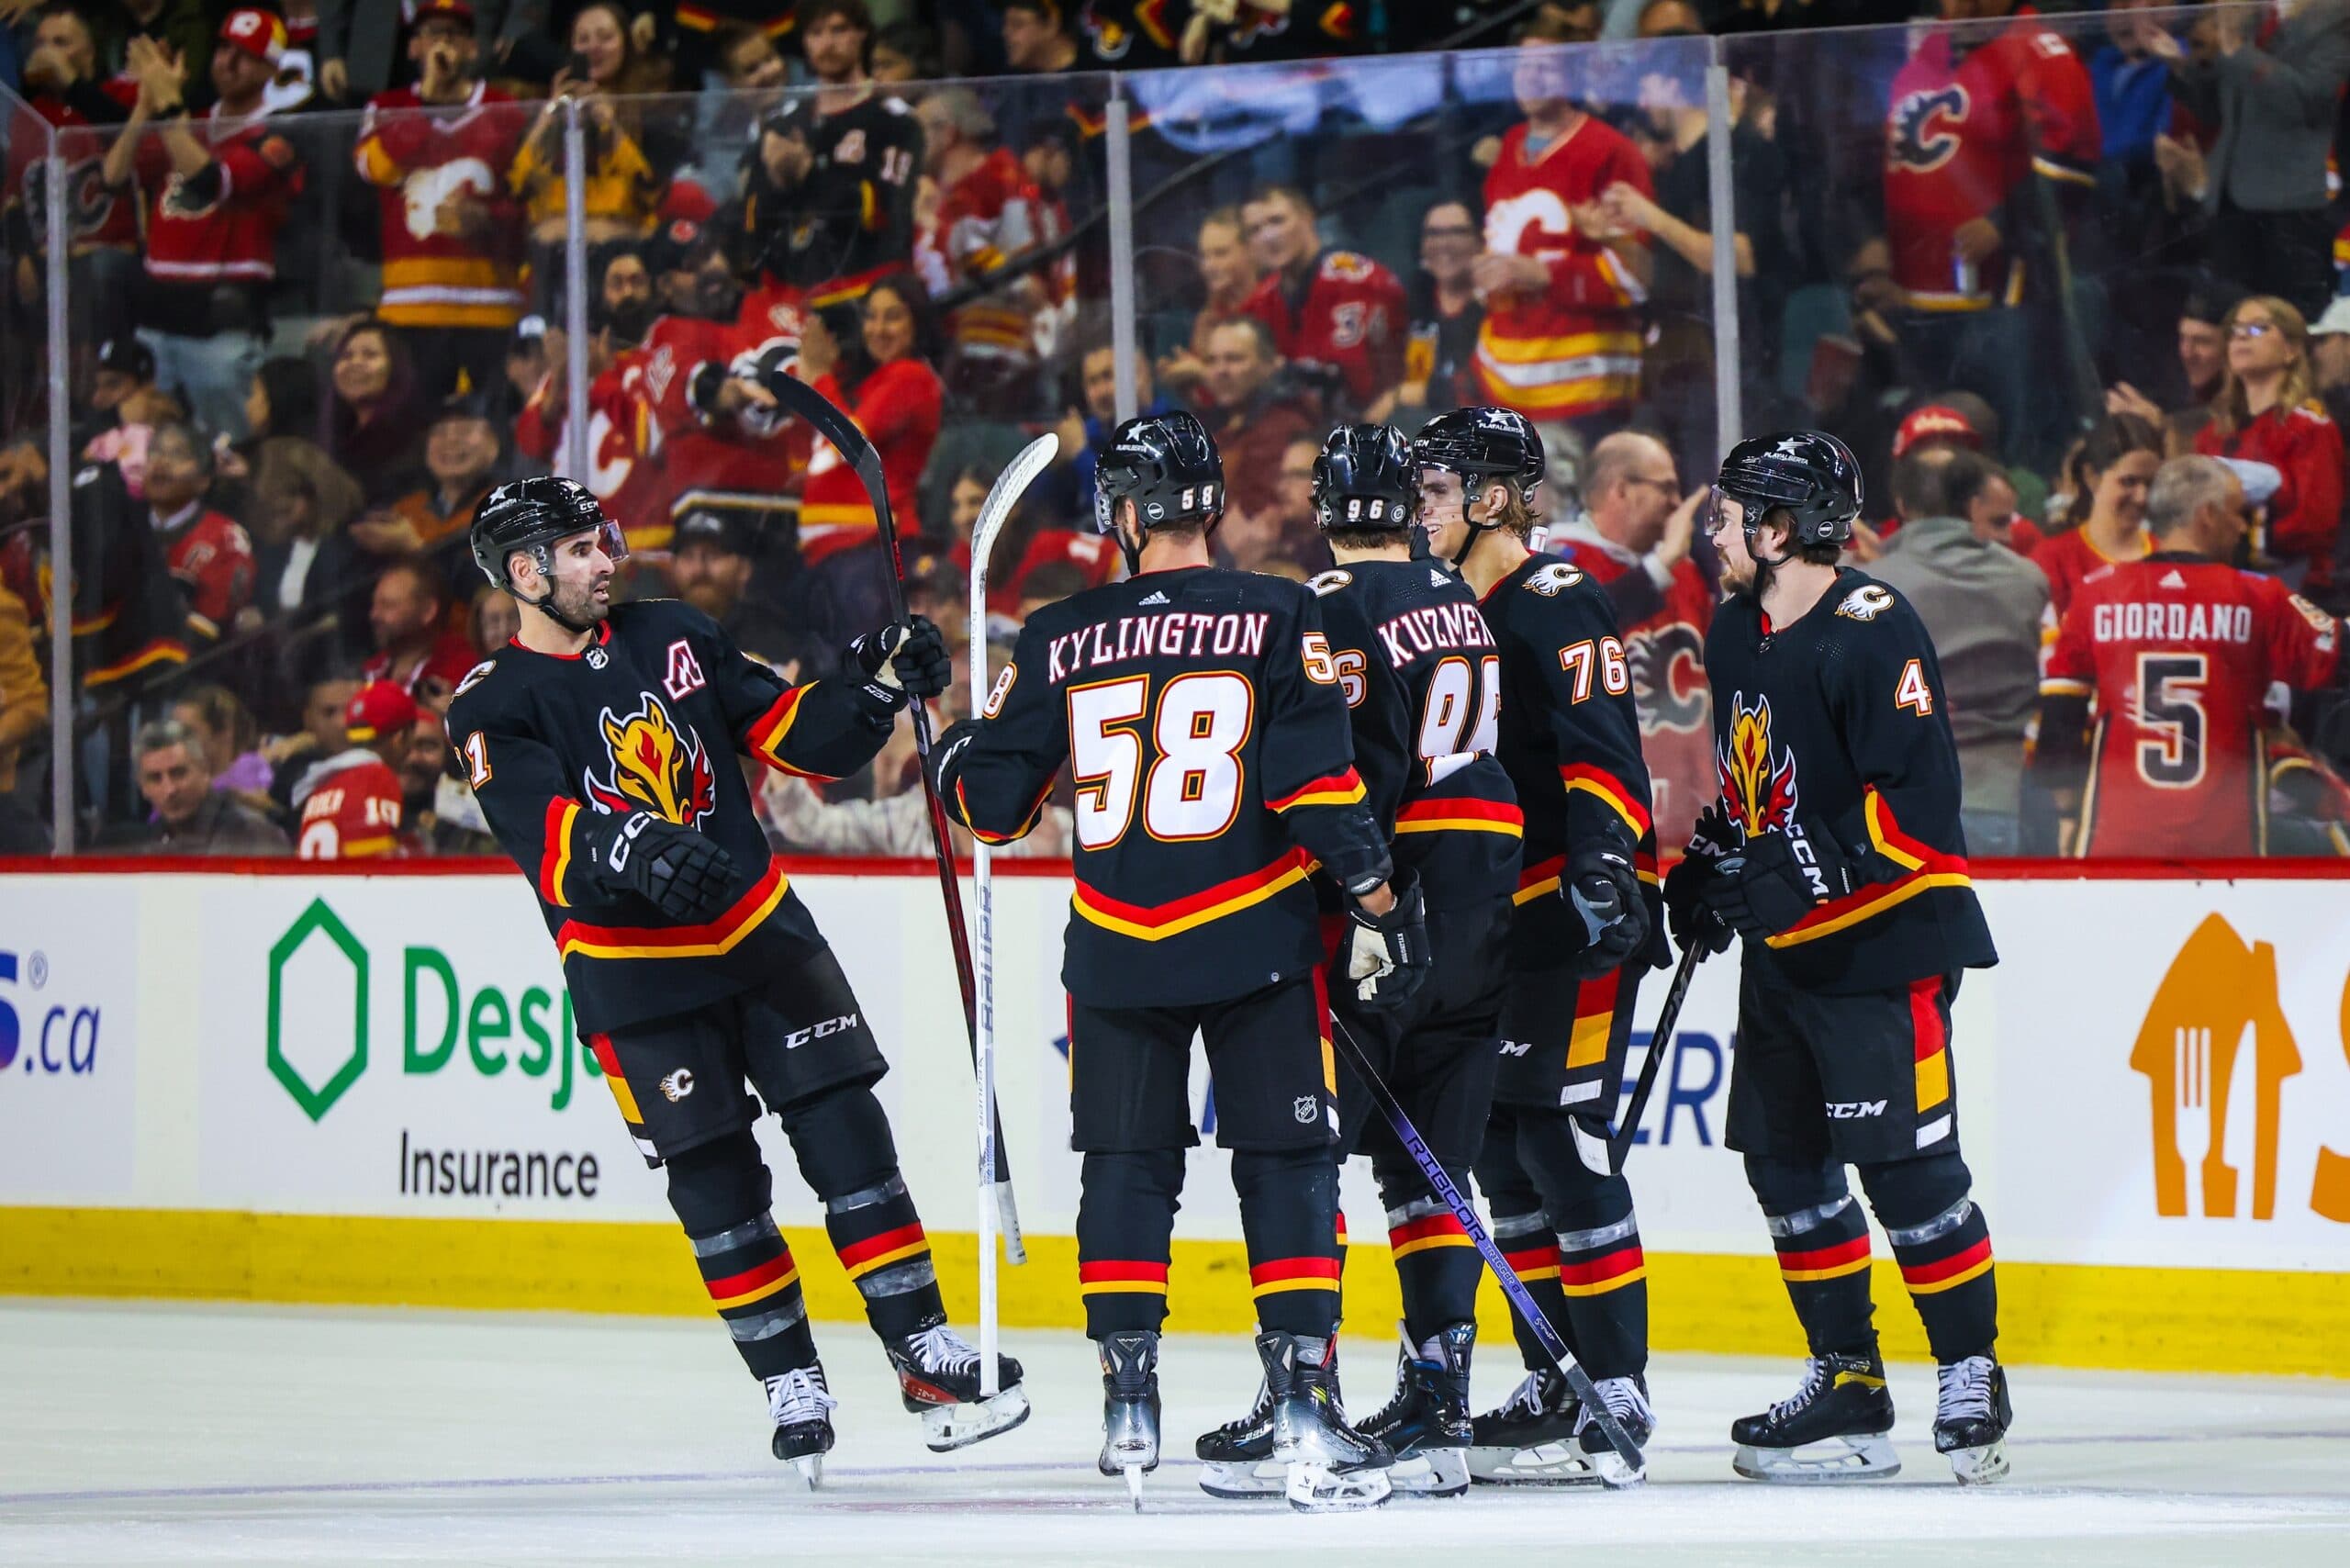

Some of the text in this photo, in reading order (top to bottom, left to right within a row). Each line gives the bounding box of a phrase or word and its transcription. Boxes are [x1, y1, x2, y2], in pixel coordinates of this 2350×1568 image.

[1181, 485, 1214, 510] 58
[1347, 498, 1384, 520] 96
[1048, 612, 1270, 686] KYLINGTON
[2093, 601, 2253, 643] GIORDANO
[662, 637, 709, 702] A
[1302, 632, 1337, 685] 5
[1559, 636, 1629, 705] 76
[1894, 657, 1933, 717] 4
[982, 661, 1018, 720] 8
[2136, 651, 2208, 790] 5
[1067, 669, 1256, 852] 58
[610, 812, 651, 873] CC
[1785, 823, 1830, 896] CCM
[404, 946, 604, 1111] Desj
[783, 1012, 858, 1050] CCM
[398, 1129, 599, 1199] Insurance
[1407, 1135, 1487, 1244] RIBCOR
[1486, 1244, 1516, 1285] TRIGGER
[1336, 1428, 1375, 1454] BAUER
